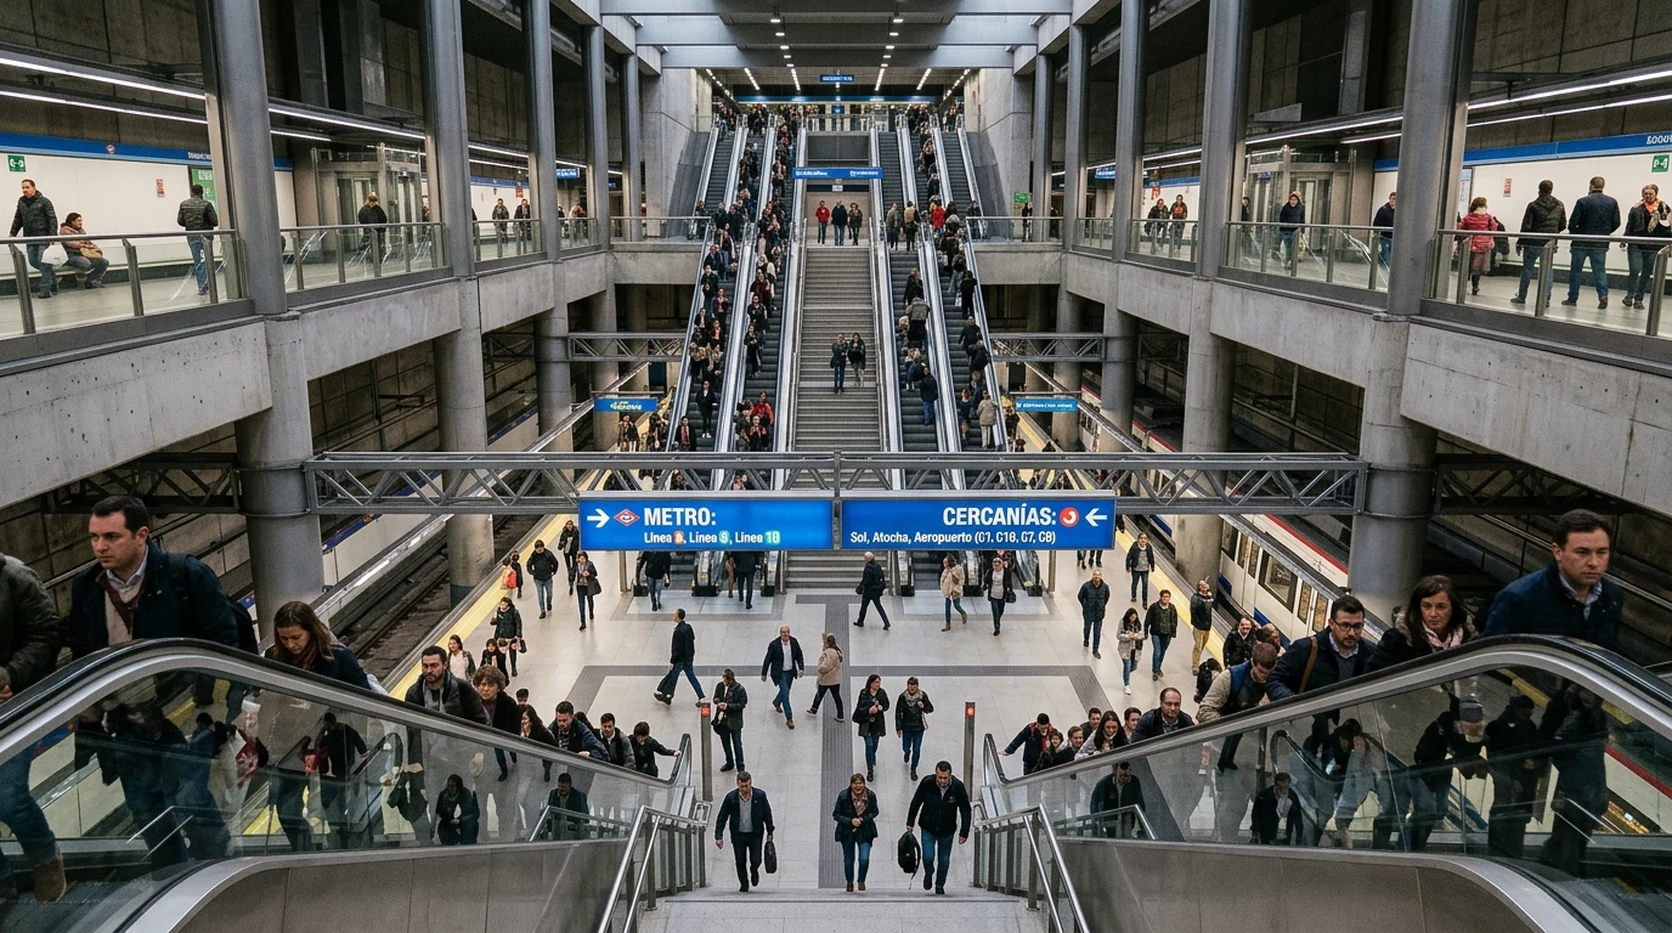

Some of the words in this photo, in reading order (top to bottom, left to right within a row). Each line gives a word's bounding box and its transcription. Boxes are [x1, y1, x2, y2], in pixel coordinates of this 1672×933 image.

[643, 507, 717, 526] METRO:
[942, 502, 1057, 526] CERCANÍAS:
[850, 531, 870, 544] Sol,
[872, 531, 912, 544] Atocha,
[914, 531, 973, 545] Aeropuerto
